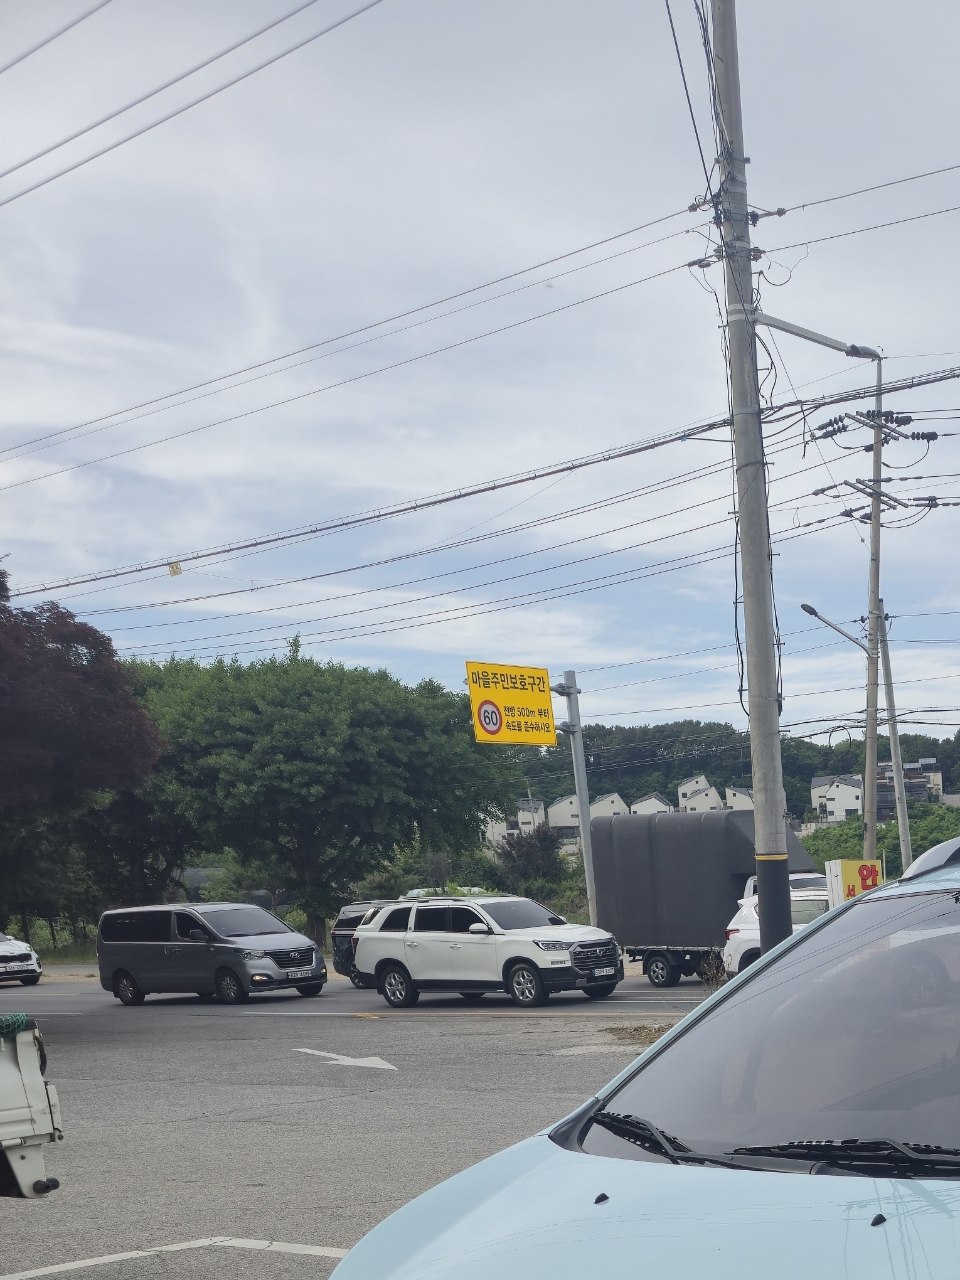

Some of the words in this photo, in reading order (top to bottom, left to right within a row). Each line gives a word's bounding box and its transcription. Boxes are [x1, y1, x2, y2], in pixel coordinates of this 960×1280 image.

[471, 670, 546, 693] 마을주민보호구간
[484, 710, 498, 726] 60
[503, 705, 516, 718] 전방
[517, 707, 536, 718] 500m
[537, 707, 550, 719] 부터
[505, 720, 523, 732] 속도를
[524, 721, 552, 733] 준수하시오
